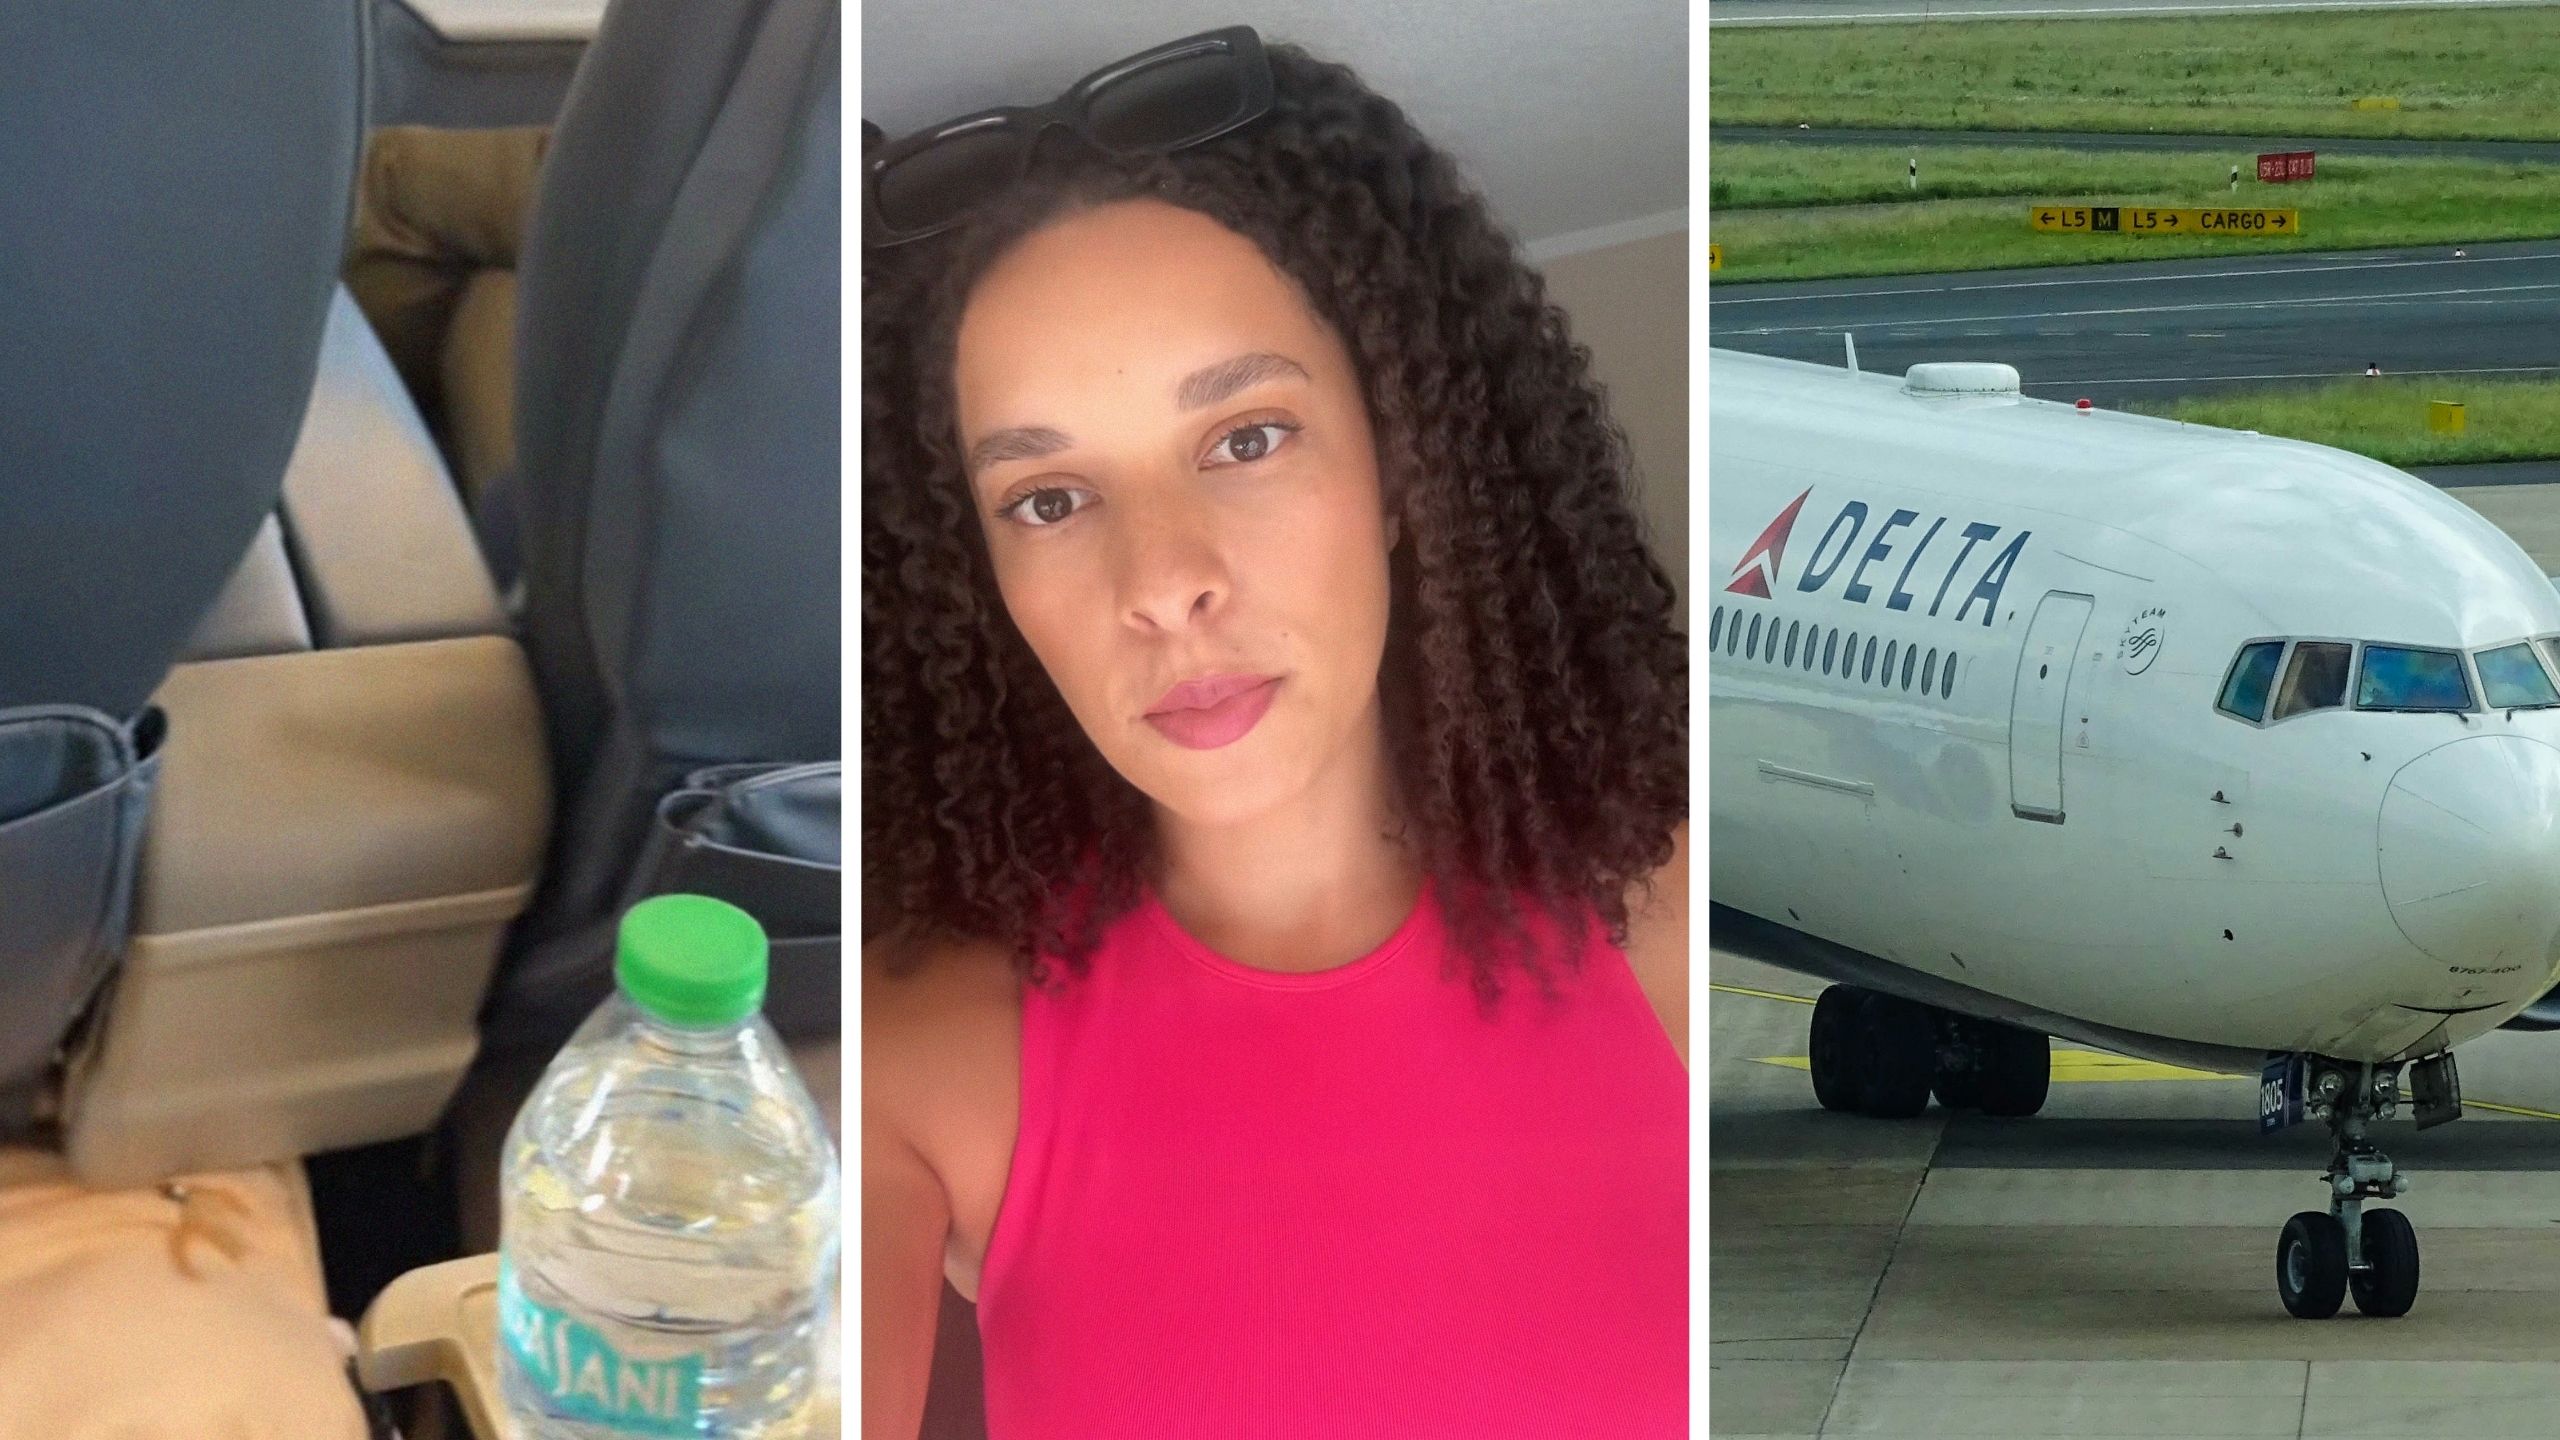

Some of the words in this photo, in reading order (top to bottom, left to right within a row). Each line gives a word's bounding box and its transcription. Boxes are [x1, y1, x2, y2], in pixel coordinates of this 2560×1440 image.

[2062, 210, 2086, 228] L5
[2099, 213, 2112, 226] M
[2133, 211, 2157, 229] L5
[2201, 212, 2266, 230] CARGO
[1796, 500, 2033, 627] DELTA
[2260, 1078, 2283, 1117] 1805
